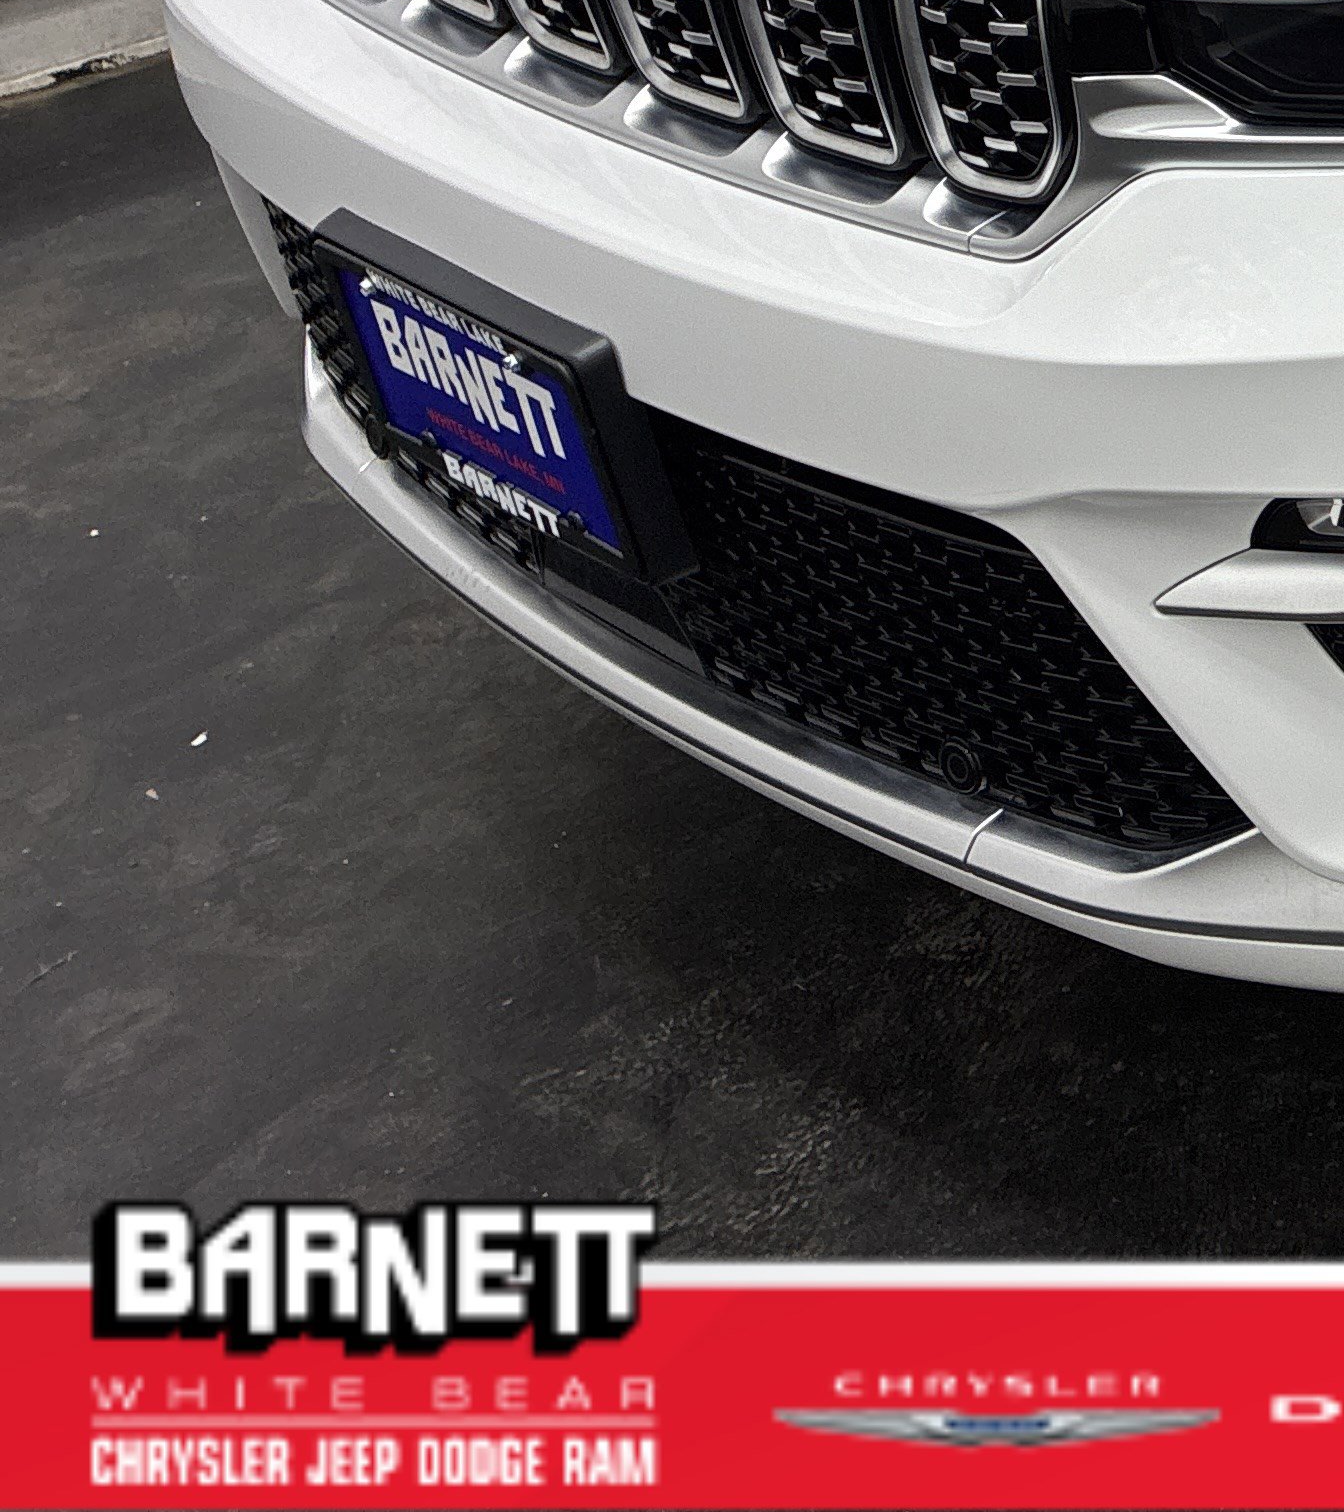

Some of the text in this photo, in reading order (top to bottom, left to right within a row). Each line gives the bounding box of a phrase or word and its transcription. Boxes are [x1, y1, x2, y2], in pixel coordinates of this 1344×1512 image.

[416, 295, 465, 335] BEAR
[460, 317, 508, 357] LAKE
[370, 298, 567, 461] BARNETT
[442, 450, 562, 538] BARNETT
